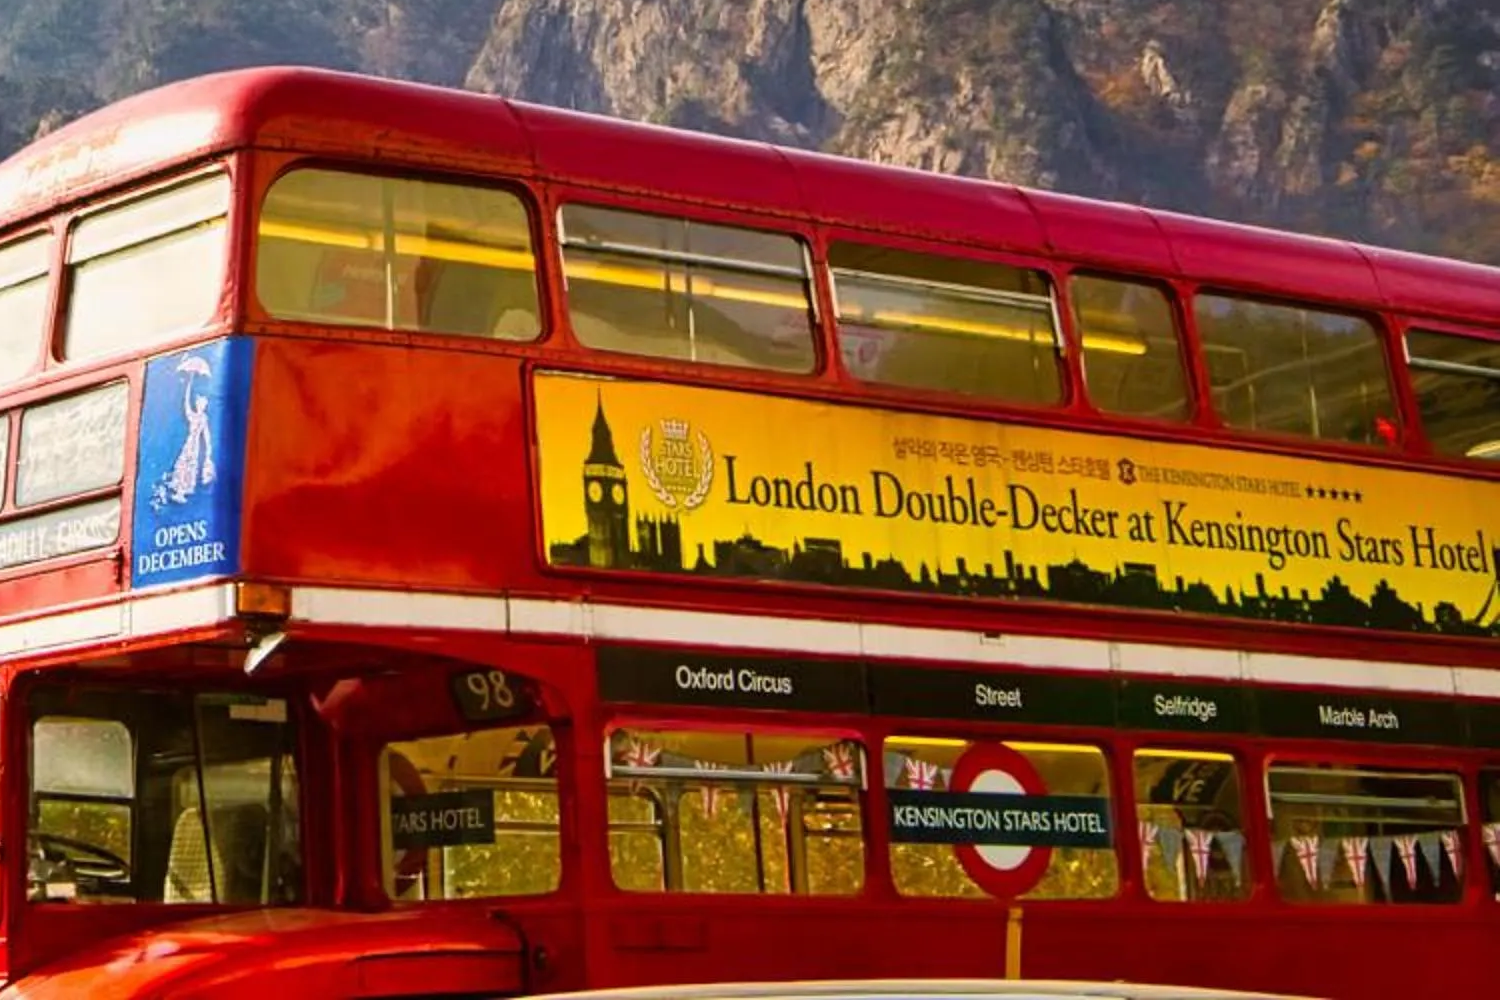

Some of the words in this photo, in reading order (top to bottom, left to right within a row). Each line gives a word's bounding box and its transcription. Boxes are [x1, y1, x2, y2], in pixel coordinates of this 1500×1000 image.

[938, 440, 970, 466] 작은
[655, 456, 701, 479] HOTEL
[1137, 465, 1160, 483] THE
[1267, 479, 1302, 498] HOTEL
[723, 455, 864, 515] London
[870, 469, 1119, 538] Double-Decker
[1127, 511, 1157, 543] at
[1163, 500, 1331, 571] Kensington
[1337, 517, 1405, 566] Stars
[1408, 525, 1490, 574] Hotel
[154, 519, 207, 548] OPENS
[138, 541, 226, 576] DECEMBER
[466, 670, 515, 711] 98
[675, 664, 735, 691] Oxford
[737, 668, 793, 695] Circus
[975, 683, 1022, 708] Street
[1153, 694, 1217, 722] Selfridge
[1318, 704, 1366, 727] Marble
[1368, 708, 1400, 729] Arch
[430, 807, 485, 831] HOTEL
[893, 806, 1000, 830] KENSINGTON
[1002, 809, 1051, 832] STARS
[1053, 812, 1109, 834] HOTEL
